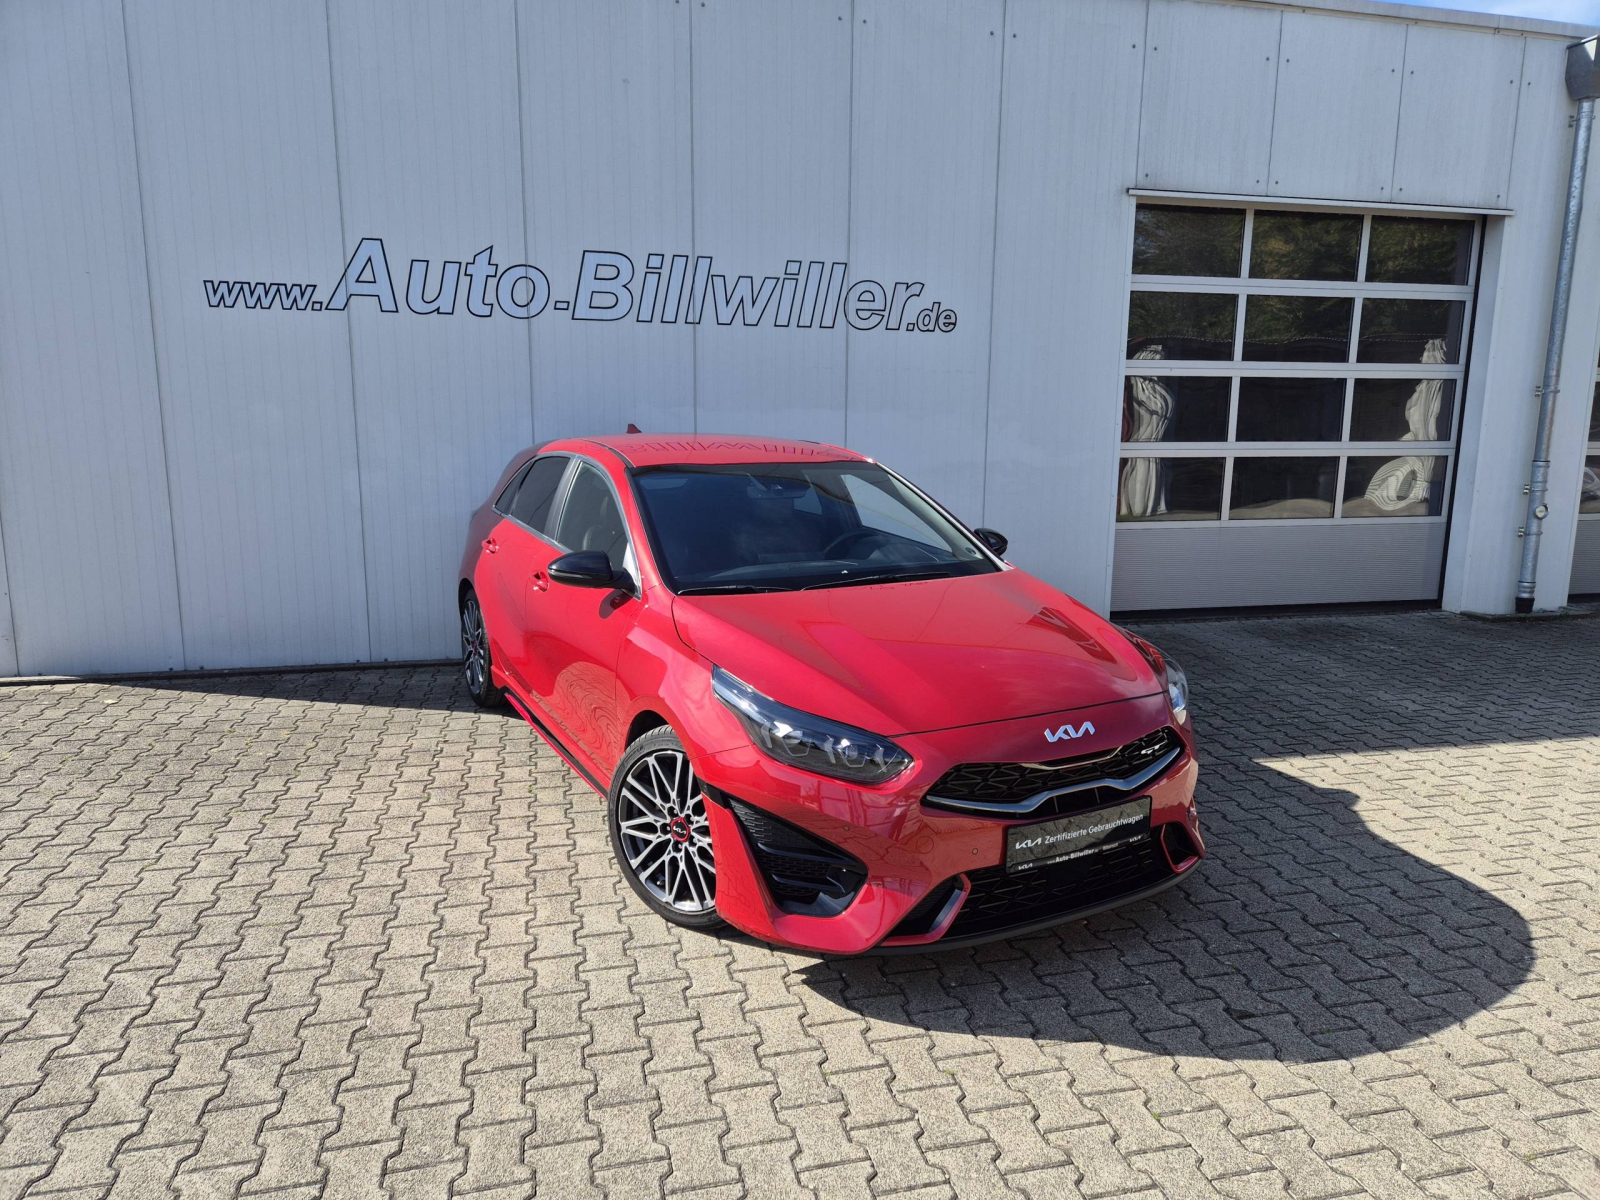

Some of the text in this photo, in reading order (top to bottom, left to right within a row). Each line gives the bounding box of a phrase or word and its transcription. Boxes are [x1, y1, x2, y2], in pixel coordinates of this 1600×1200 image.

[202, 237, 958, 333] www.Auto-Billwiller.de
[1043, 720, 1096, 743] KIA
[1015, 814, 1143, 850] KIA Zertifizierte Gebrauchtwagen
